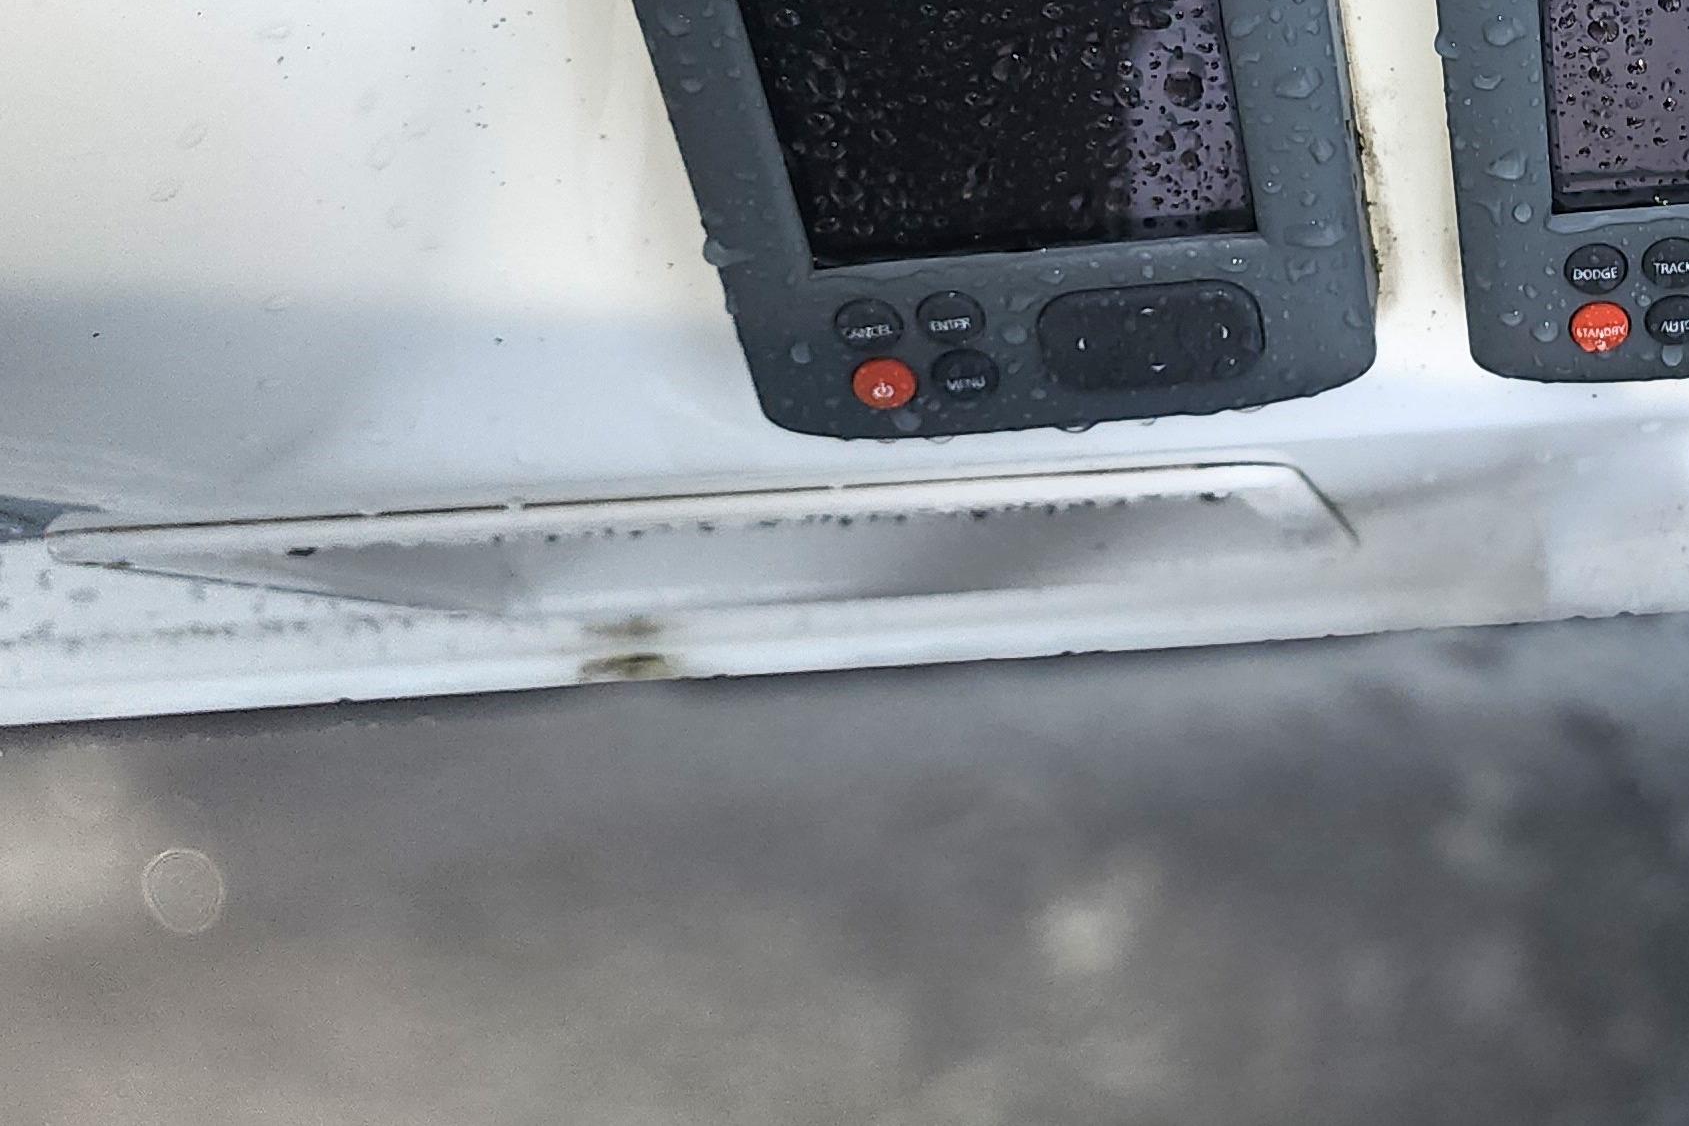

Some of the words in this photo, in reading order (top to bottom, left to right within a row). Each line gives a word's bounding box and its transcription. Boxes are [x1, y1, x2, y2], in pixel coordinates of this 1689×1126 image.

[1573, 266, 1618, 281] DODGE
[928, 316, 972, 332] ENTER
[1575, 324, 1627, 340] STANDBY
